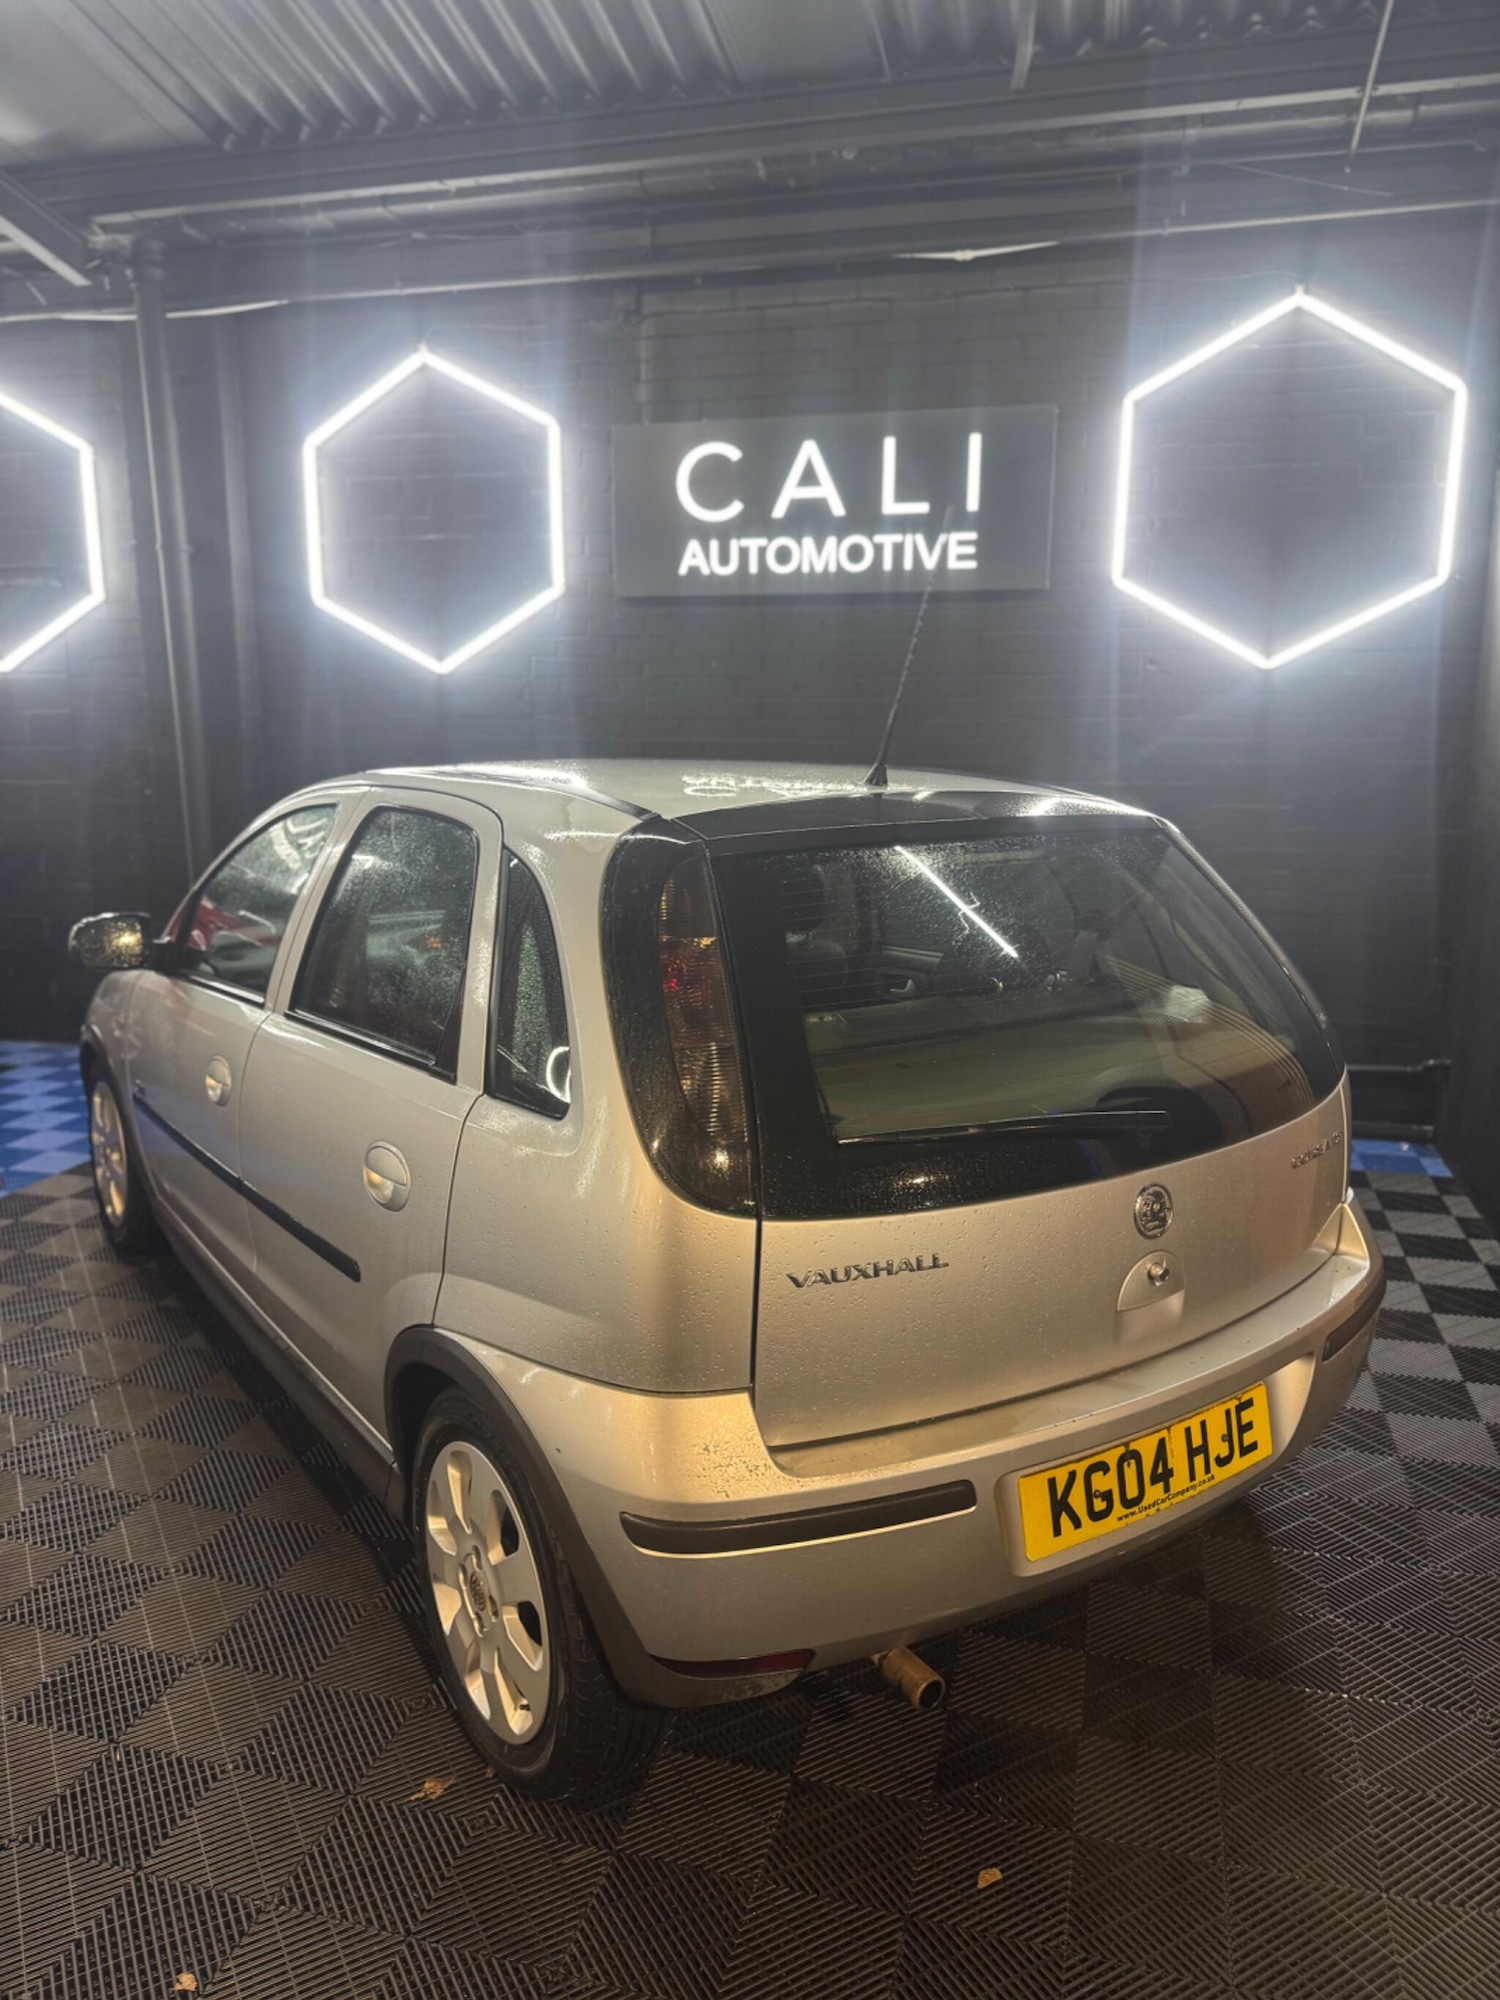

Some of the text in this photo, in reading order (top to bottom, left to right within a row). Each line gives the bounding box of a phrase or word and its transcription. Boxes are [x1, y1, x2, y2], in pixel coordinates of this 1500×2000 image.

[676, 433, 982, 523] CALI
[678, 532, 978, 576] AUTOMOTIVE
[786, 1252, 949, 1289] VAUXHALL
[1047, 1397, 1259, 1539] KG04 HJE
